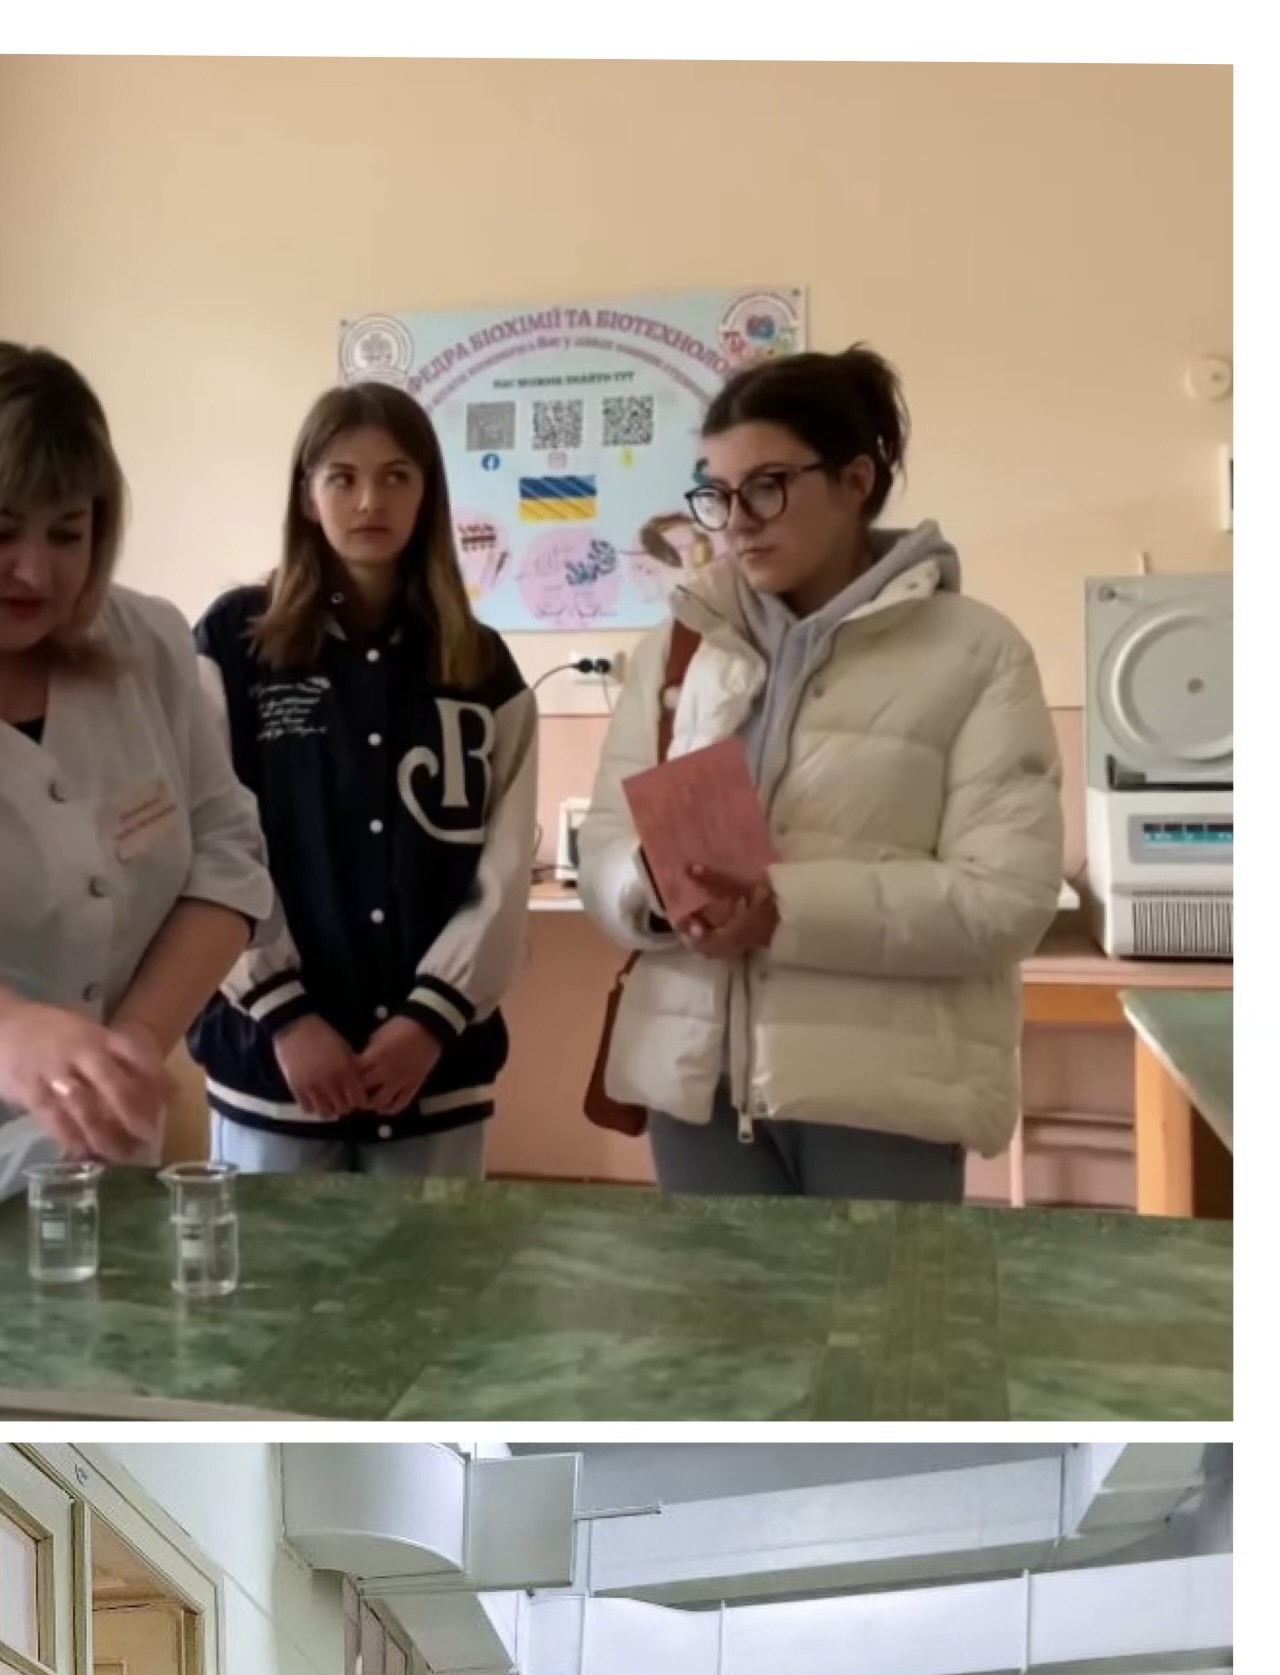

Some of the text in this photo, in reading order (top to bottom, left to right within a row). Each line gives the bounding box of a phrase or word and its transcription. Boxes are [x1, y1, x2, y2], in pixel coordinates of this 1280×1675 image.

[407, 342, 469, 393] ФЕДРА
[469, 305, 561, 350] БІОХІМІЇ
[564, 309, 591, 328] ТА
[596, 309, 730, 374] БІОТЕХНОЛО
